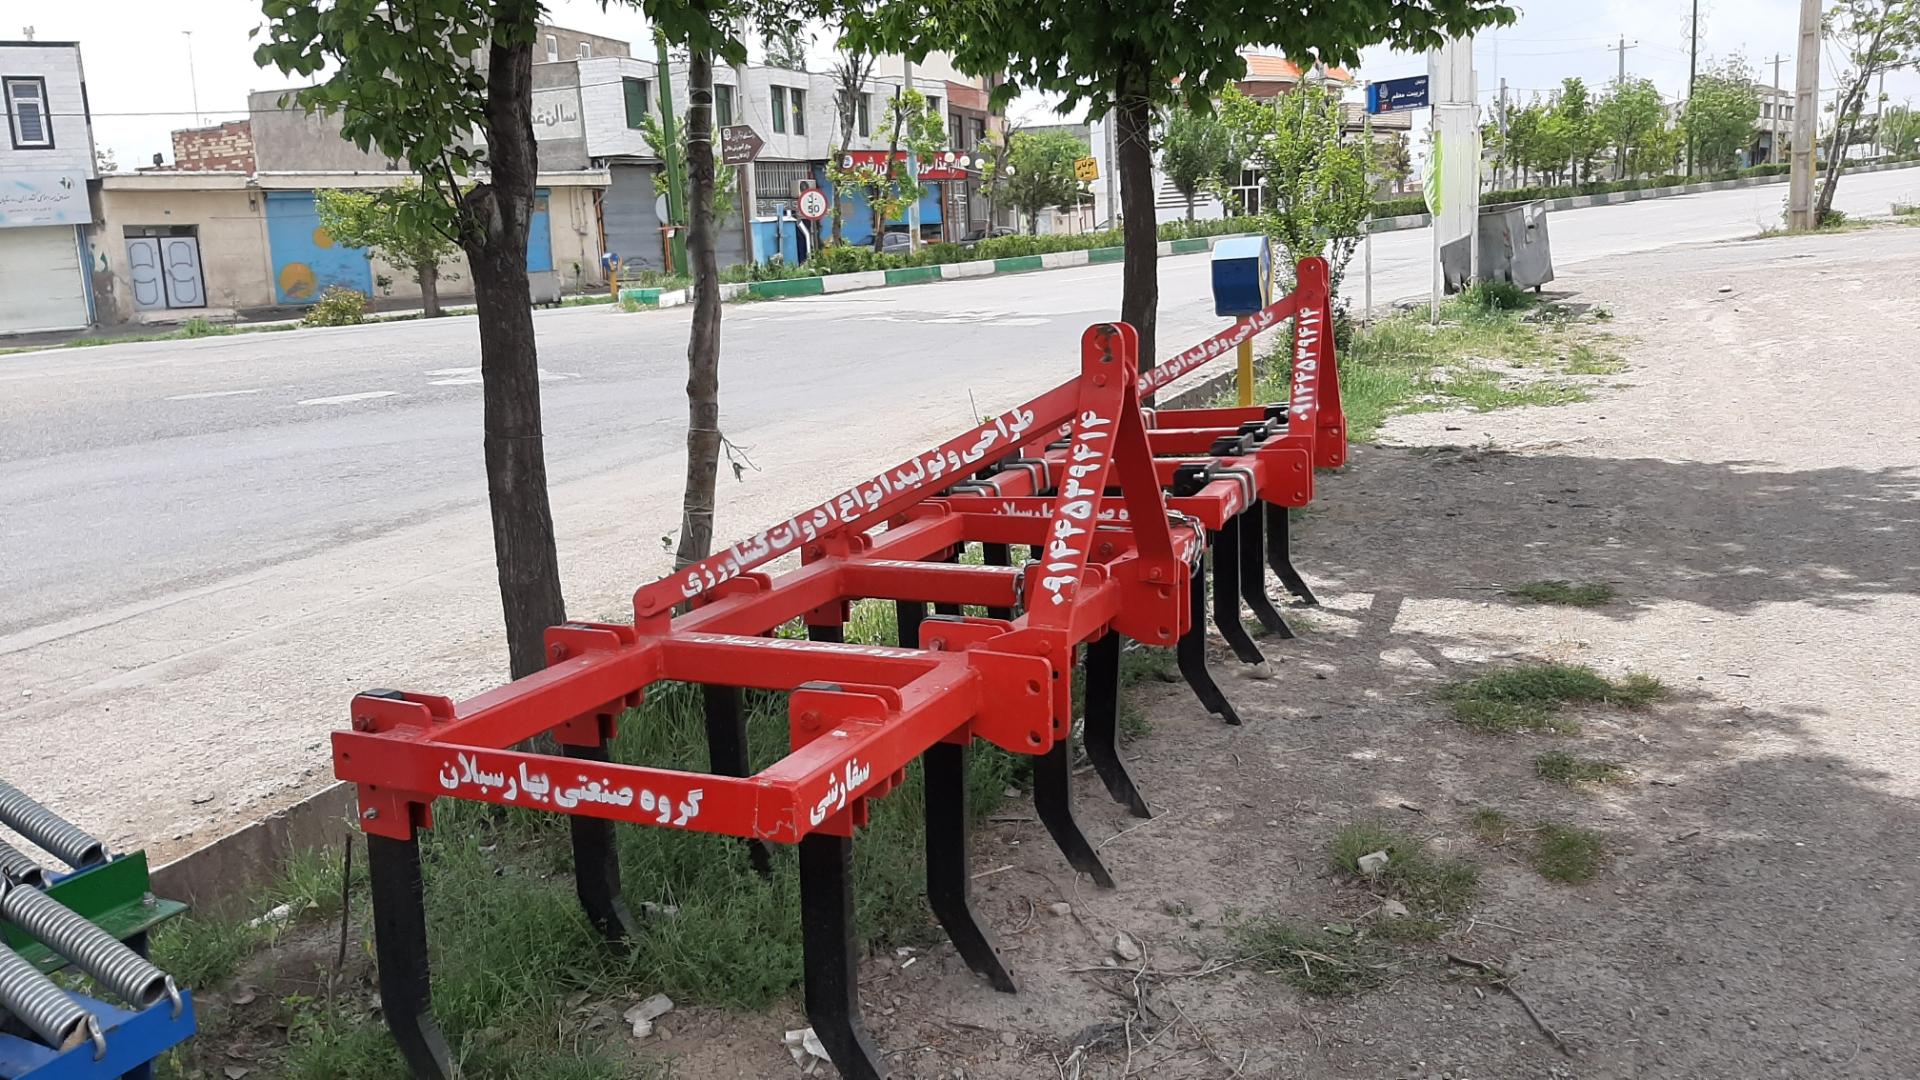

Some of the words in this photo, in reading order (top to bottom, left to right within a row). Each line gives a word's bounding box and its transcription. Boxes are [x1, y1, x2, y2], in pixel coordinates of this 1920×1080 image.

[546, 103, 577, 127] سالن
[808, 204, 820, 214] 50
[1223, 309, 1275, 348] طراحی
[1150, 355, 1192, 391] انواع
[1291, 307, 1320, 420] ۰۹۱۴۴۵۳۹۴۱۴
[962, 409, 1035, 464] طراحی
[834, 475, 893, 523] انواع
[1043, 410, 1112, 605] ۰۹۱۴۴۵۳۹۴۱۴
[765, 502, 838, 558] ادوات
[682, 533, 777, 598] کشاورزی
[440, 751, 504, 794] سبلان
[554, 775, 633, 809] صنعتی
[810, 758, 870, 827] سفارشی
[640, 789, 703, 826] گروه
